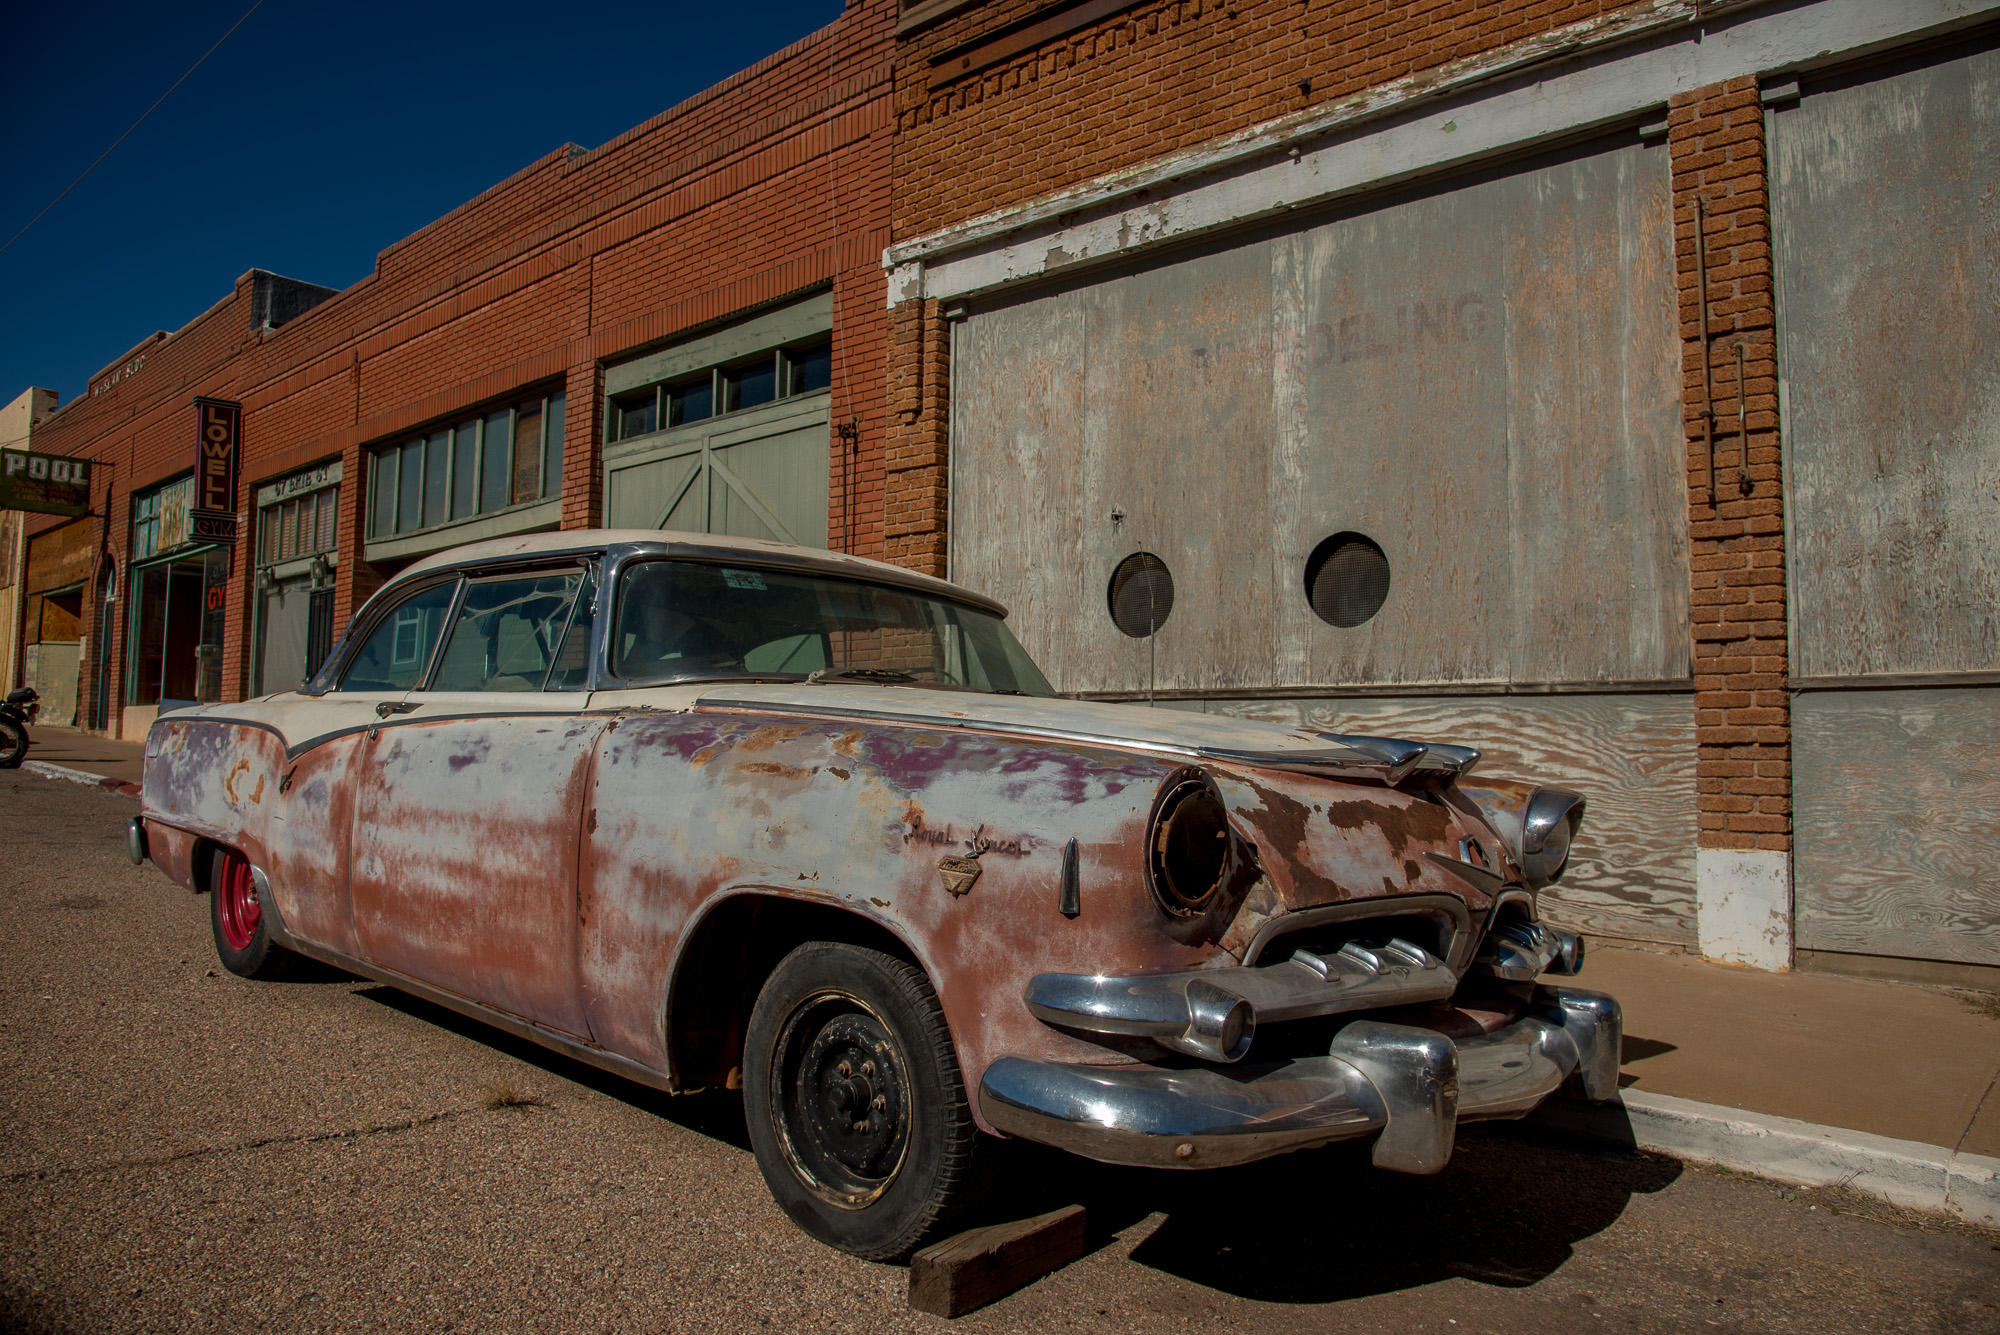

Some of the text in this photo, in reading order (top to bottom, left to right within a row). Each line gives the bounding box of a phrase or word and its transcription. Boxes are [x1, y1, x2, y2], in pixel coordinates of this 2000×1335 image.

[4, 453, 89, 485] POOL
[202, 407, 232, 510] LOWELL
[289, 472, 311, 492] ERIE
[316, 464, 330, 482] ST
[197, 519, 234, 536] GYM
[208, 587, 225, 610] GY
[909, 815, 958, 847] Royal
